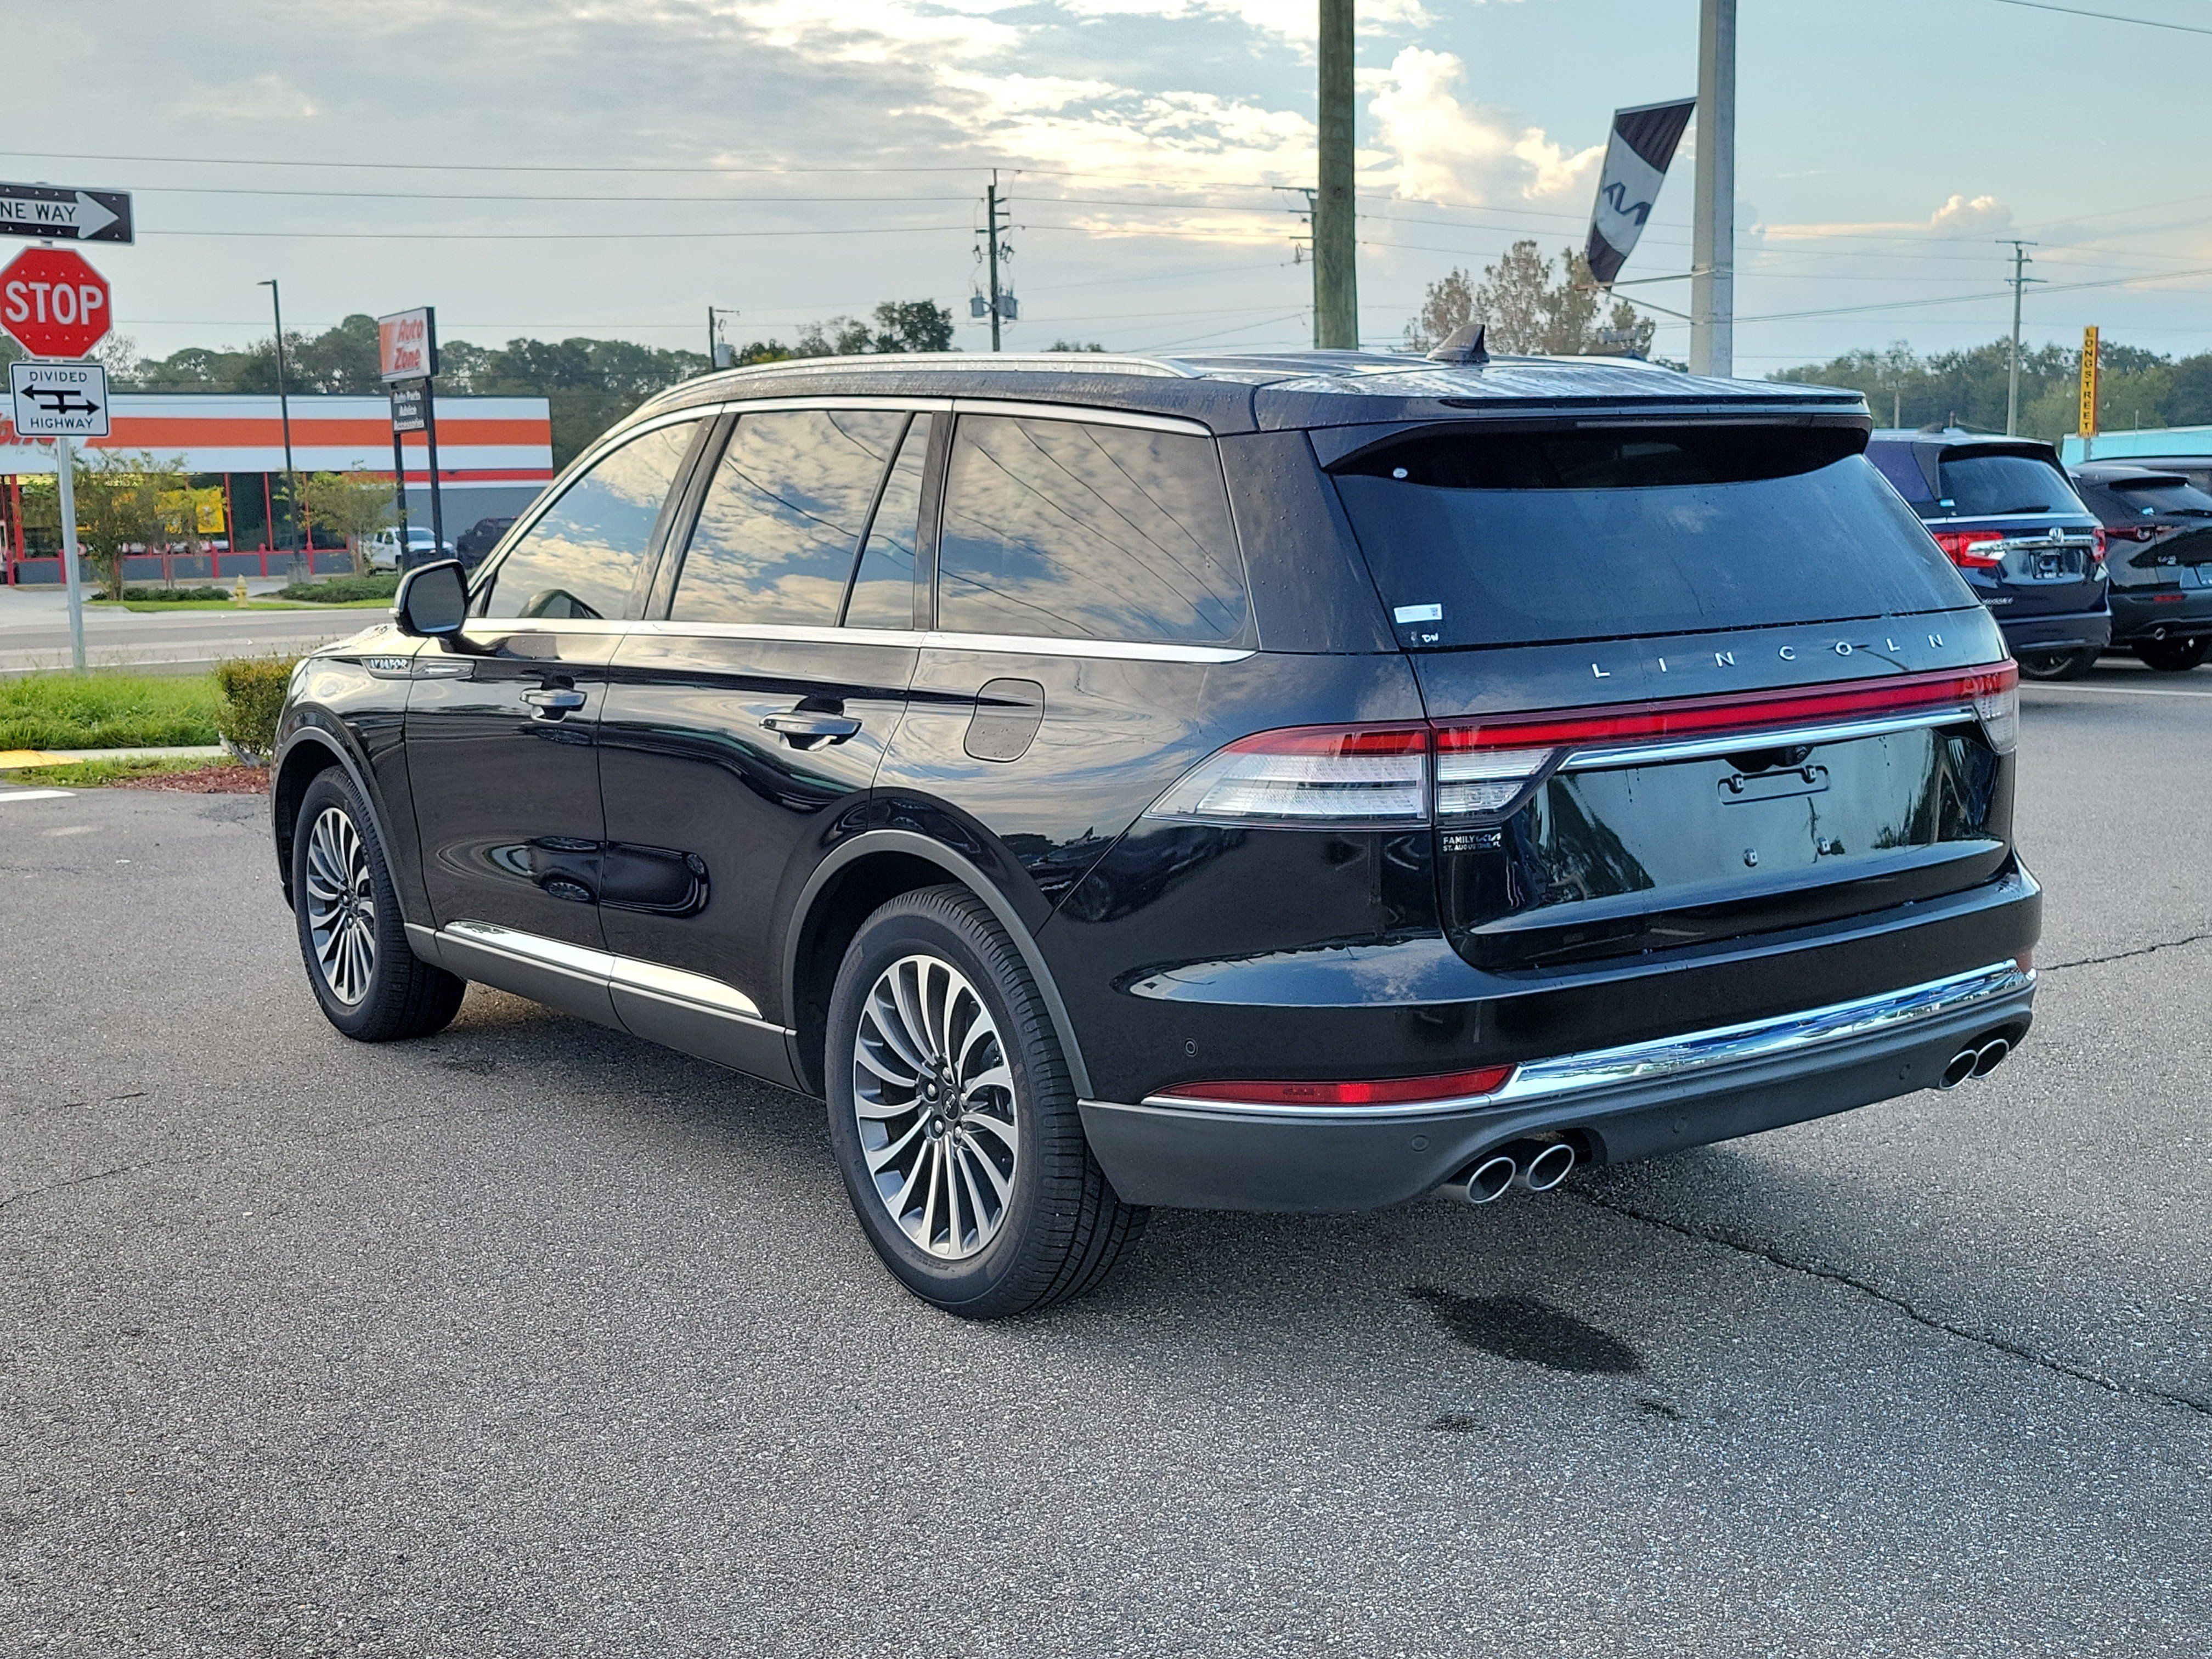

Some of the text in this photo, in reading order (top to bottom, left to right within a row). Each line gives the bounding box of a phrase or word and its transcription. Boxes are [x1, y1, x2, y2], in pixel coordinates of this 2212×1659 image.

[35, 204, 76, 222] WAY
[5, 280, 103, 325] STOP
[394, 347, 420, 370] Zone
[30, 371, 87, 382] DIVIDED
[2084, 328, 2093, 430] LONGSTREET
[30, 417, 93, 428] HIGHWAY
[1592, 633, 1944, 678] LINCOLN
[1443, 835, 1475, 845] FAMILY
